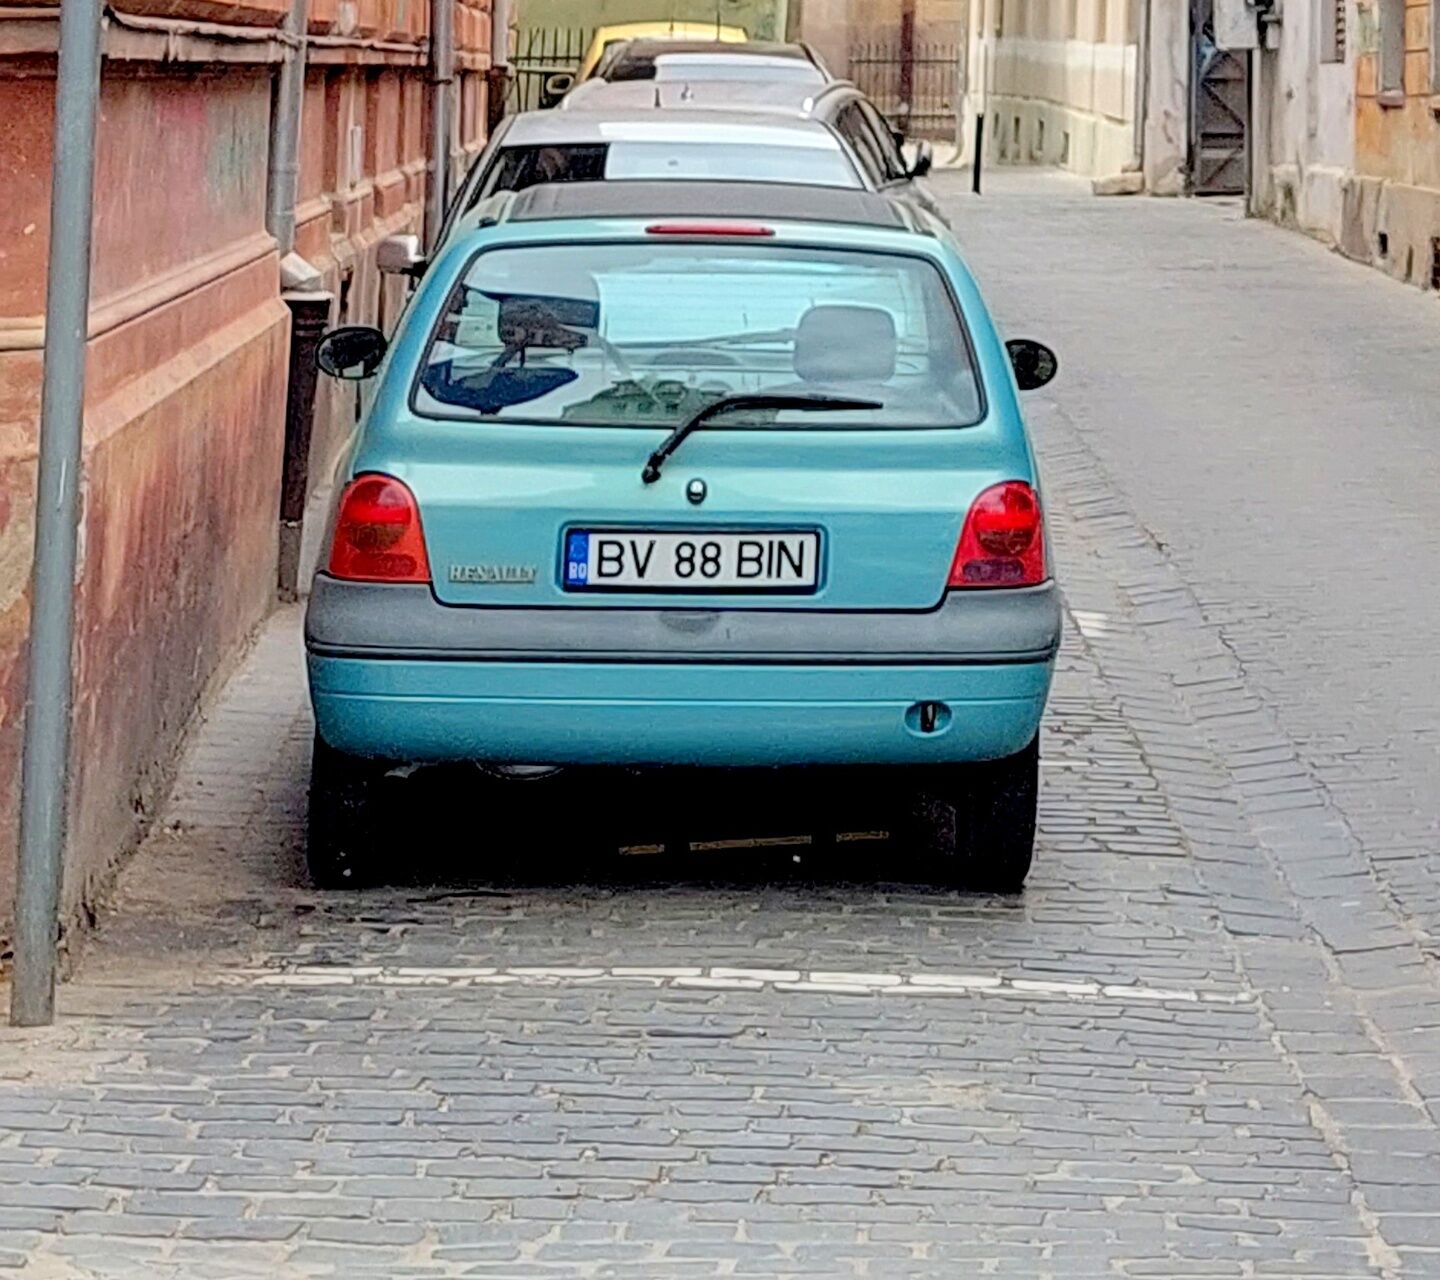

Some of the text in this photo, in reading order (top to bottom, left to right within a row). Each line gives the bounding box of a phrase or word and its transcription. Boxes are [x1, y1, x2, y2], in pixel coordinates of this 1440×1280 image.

[568, 561, 587, 580] RO
[597, 540, 804, 578] BV 88 BIN
